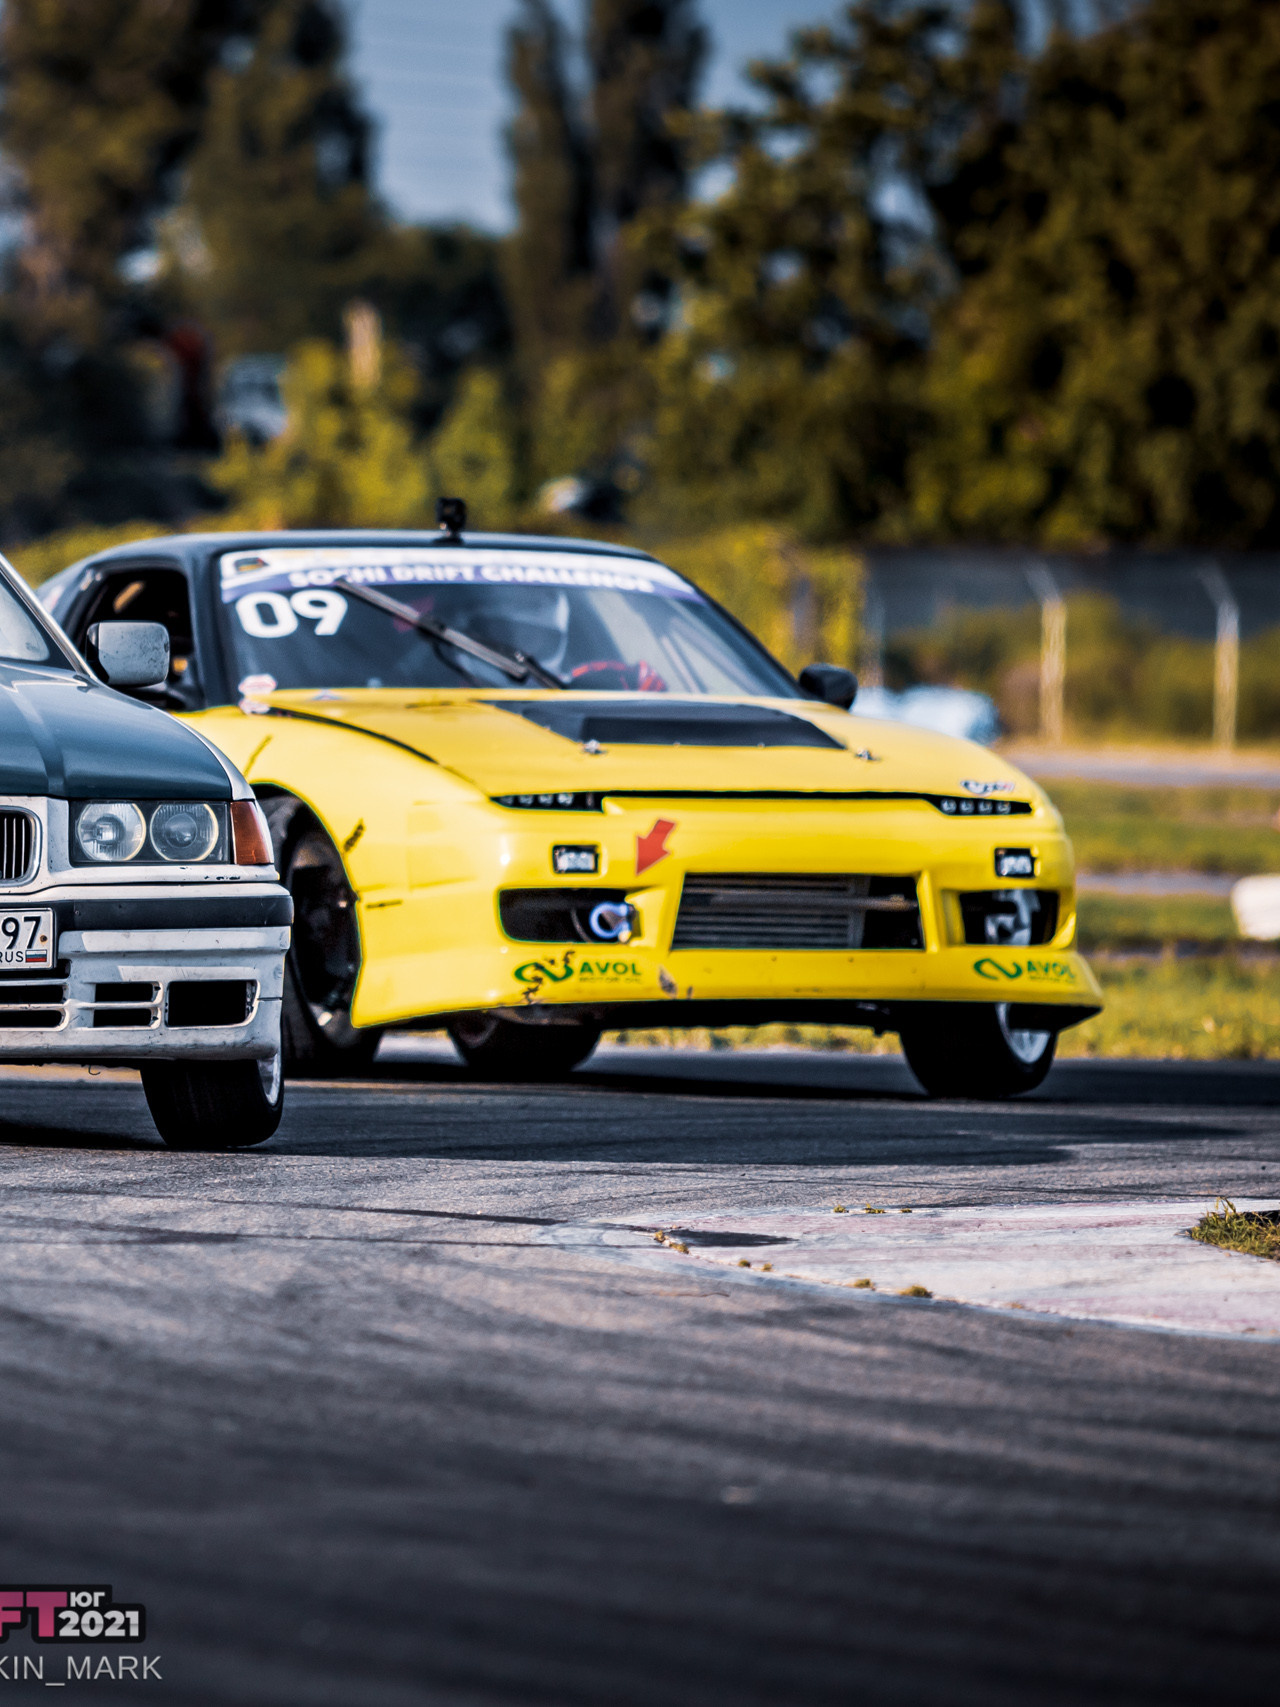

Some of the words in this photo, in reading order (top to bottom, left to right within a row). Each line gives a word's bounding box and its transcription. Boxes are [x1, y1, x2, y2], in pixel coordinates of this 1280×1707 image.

[391, 564, 475, 583] DRIFT
[235, 588, 349, 638] 09
[579, 961, 642, 976] AVOL
[1026, 960, 1076, 979] AVOL
